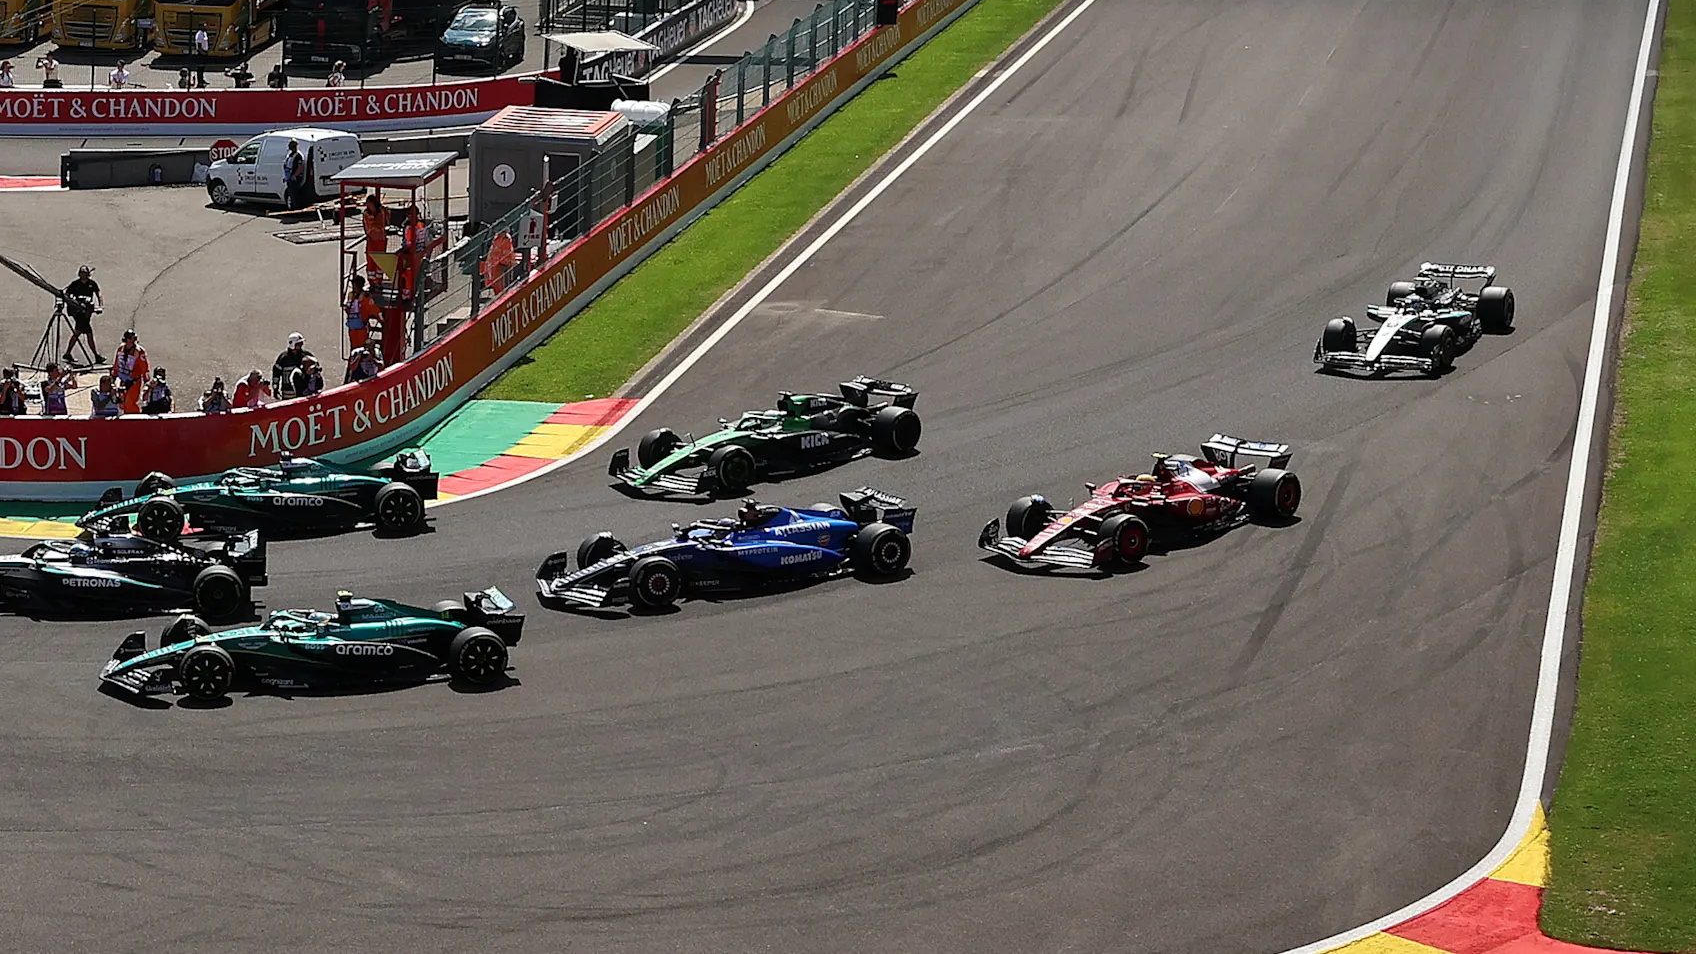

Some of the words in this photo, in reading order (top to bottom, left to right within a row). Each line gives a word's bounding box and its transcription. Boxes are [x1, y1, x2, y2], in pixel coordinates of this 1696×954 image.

[808, 69, 838, 108] CHANDON
[70, 98, 87, 118] &
[91, 98, 217, 119] CHANDON
[297, 92, 361, 116] MOËT
[366, 94, 380, 114] &
[386, 88, 480, 112] CHANDON
[211, 146, 236, 160] STOP
[705, 149, 727, 189] MOËT
[732, 122, 767, 166] CHANDON
[500, 170, 508, 182] 1
[608, 222, 634, 260] MOËT
[634, 220, 641, 243] &
[640, 185, 680, 239] CHANDON
[490, 298, 522, 352] MOËT
[521, 296, 530, 322] &
[528, 260, 577, 318] CHANDON
[248, 404, 347, 457] MOËT
[353, 399, 372, 433] &
[374, 352, 454, 425] CHANDON
[800, 432, 830, 449] KICK
[272, 496, 324, 507] aramco
[774, 521, 831, 537] ATLASSIAN
[738, 546, 779, 556] MYPROTEIN
[780, 550, 823, 565] KOMATSU
[62, 578, 122, 588] PETRONAS
[336, 644, 394, 656] aramco
